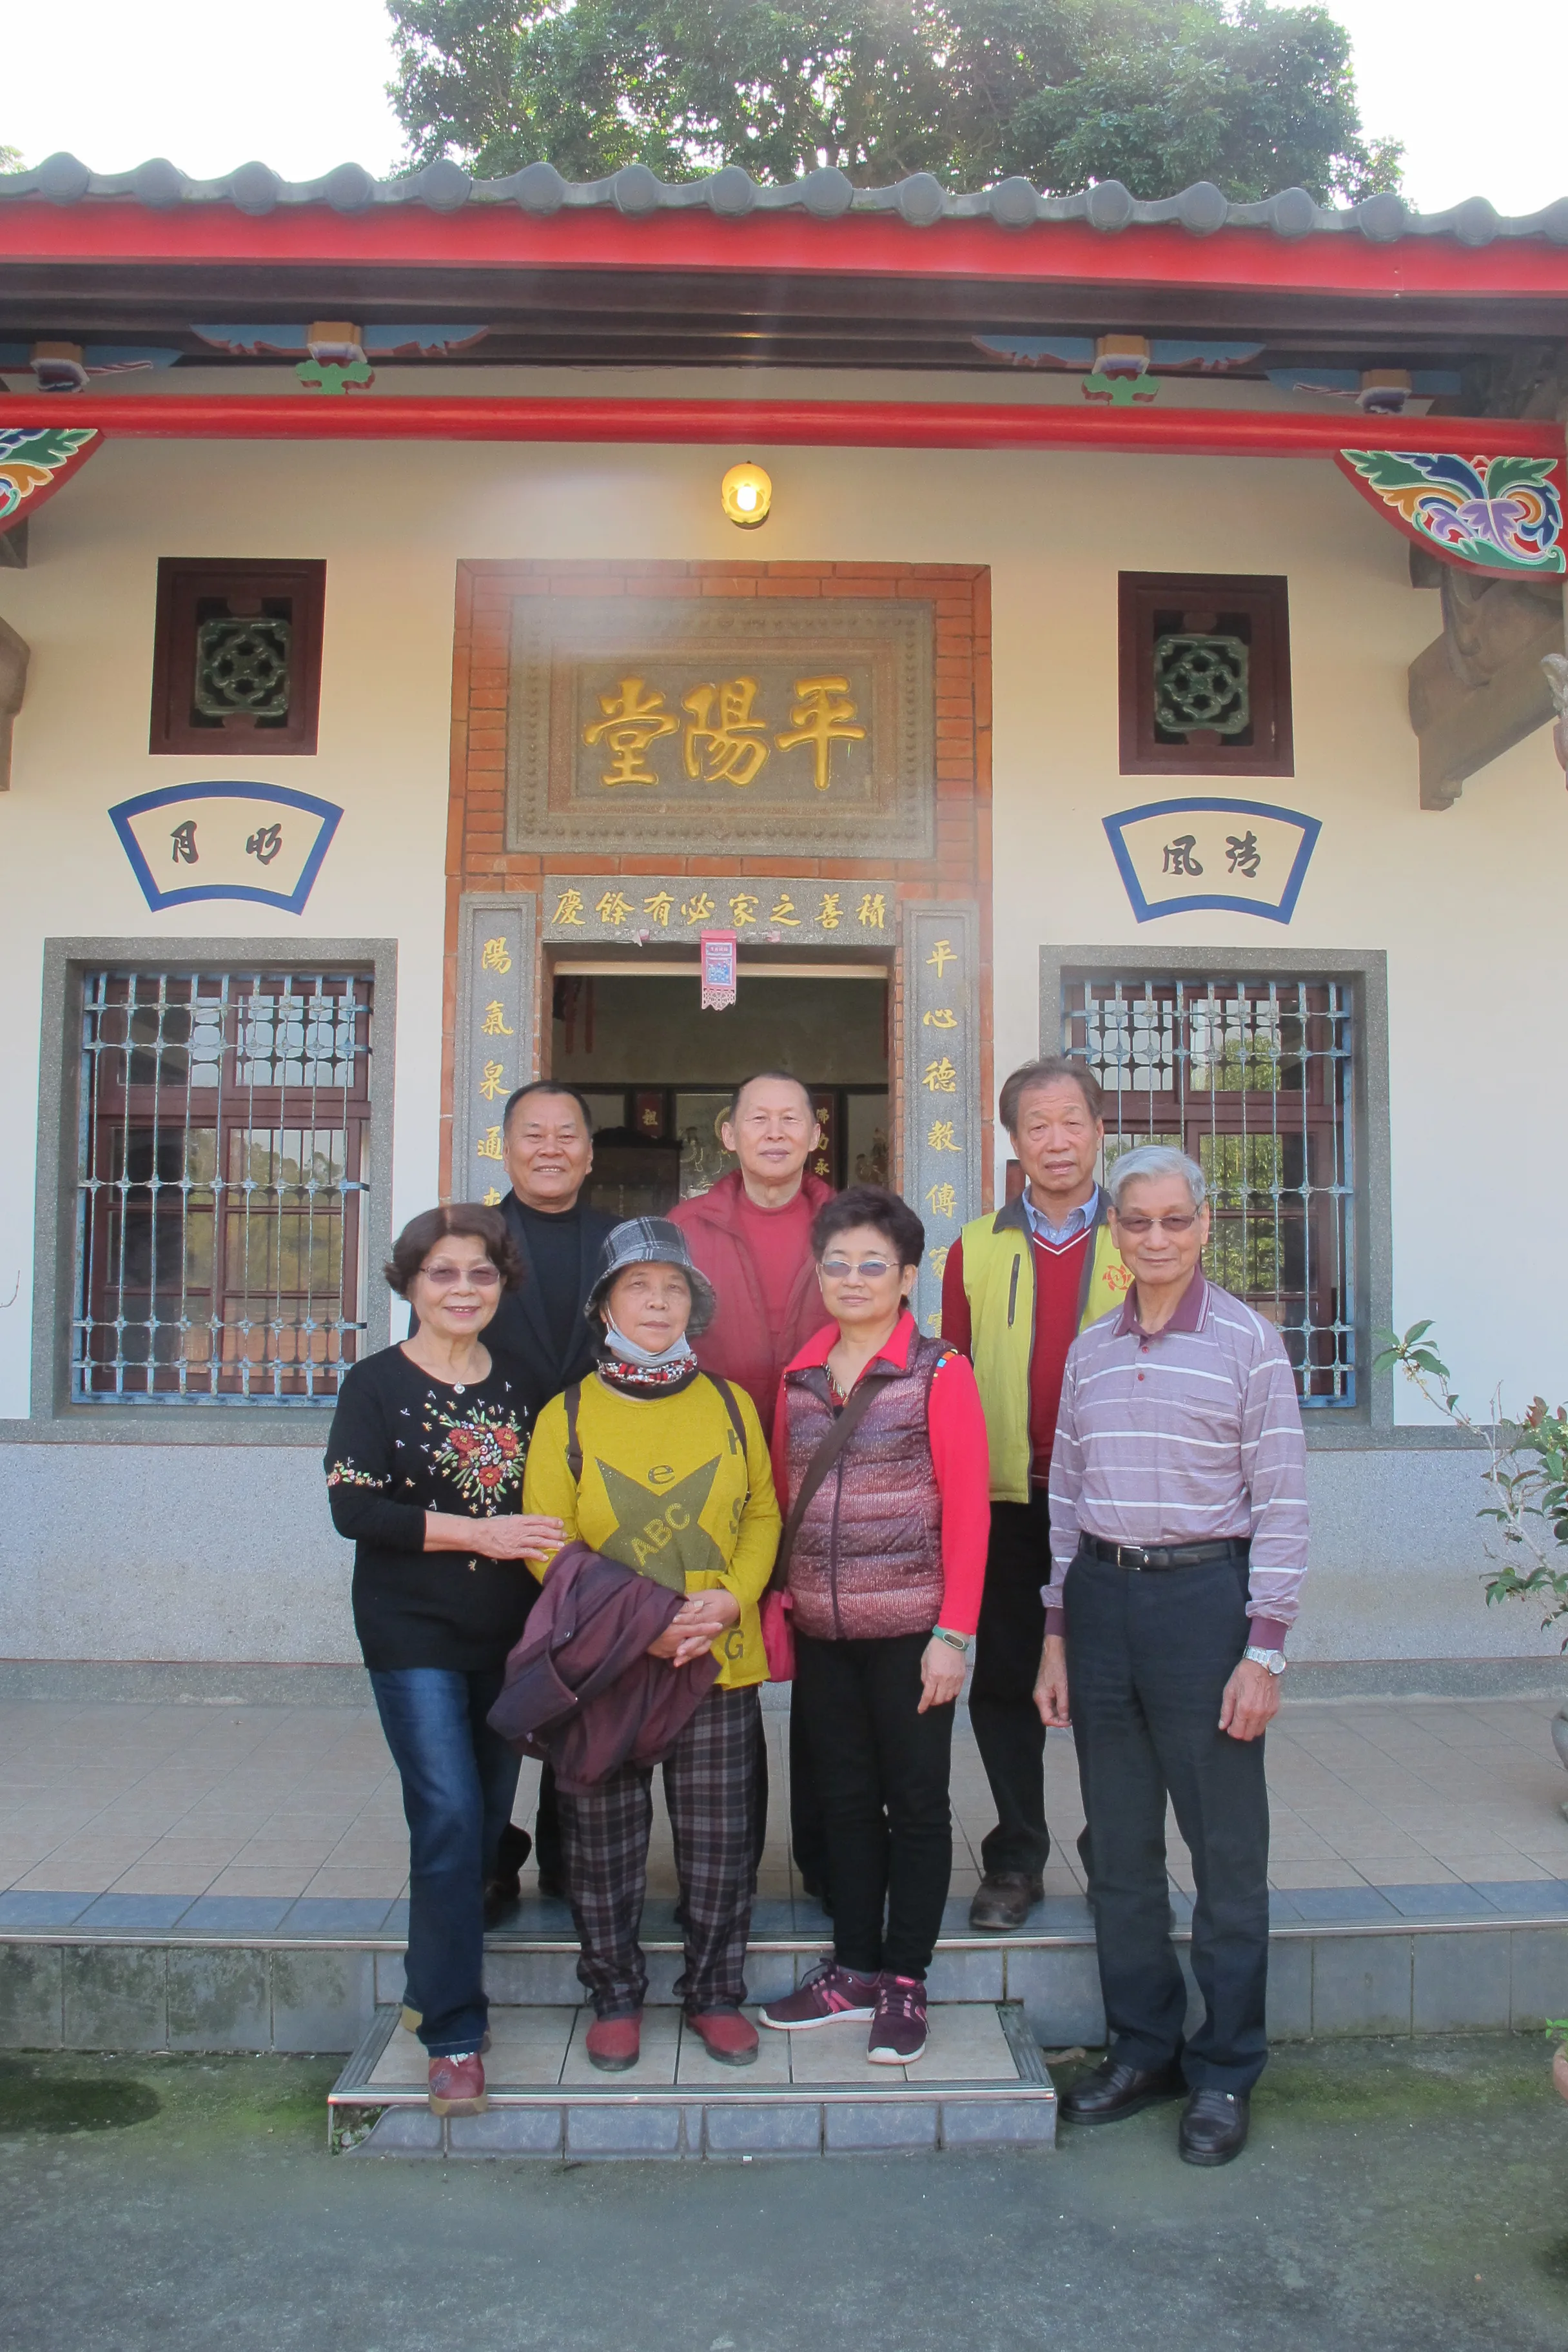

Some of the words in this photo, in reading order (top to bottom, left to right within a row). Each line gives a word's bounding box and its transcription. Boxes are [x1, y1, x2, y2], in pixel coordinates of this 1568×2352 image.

[583, 674, 866, 790] 平陽堂
[1162, 830, 1261, 878] 清風
[551, 888, 887, 929] 積善之家必有餘慶
[631, 1502, 691, 1567] ABC
[724, 1629, 744, 1660] G
